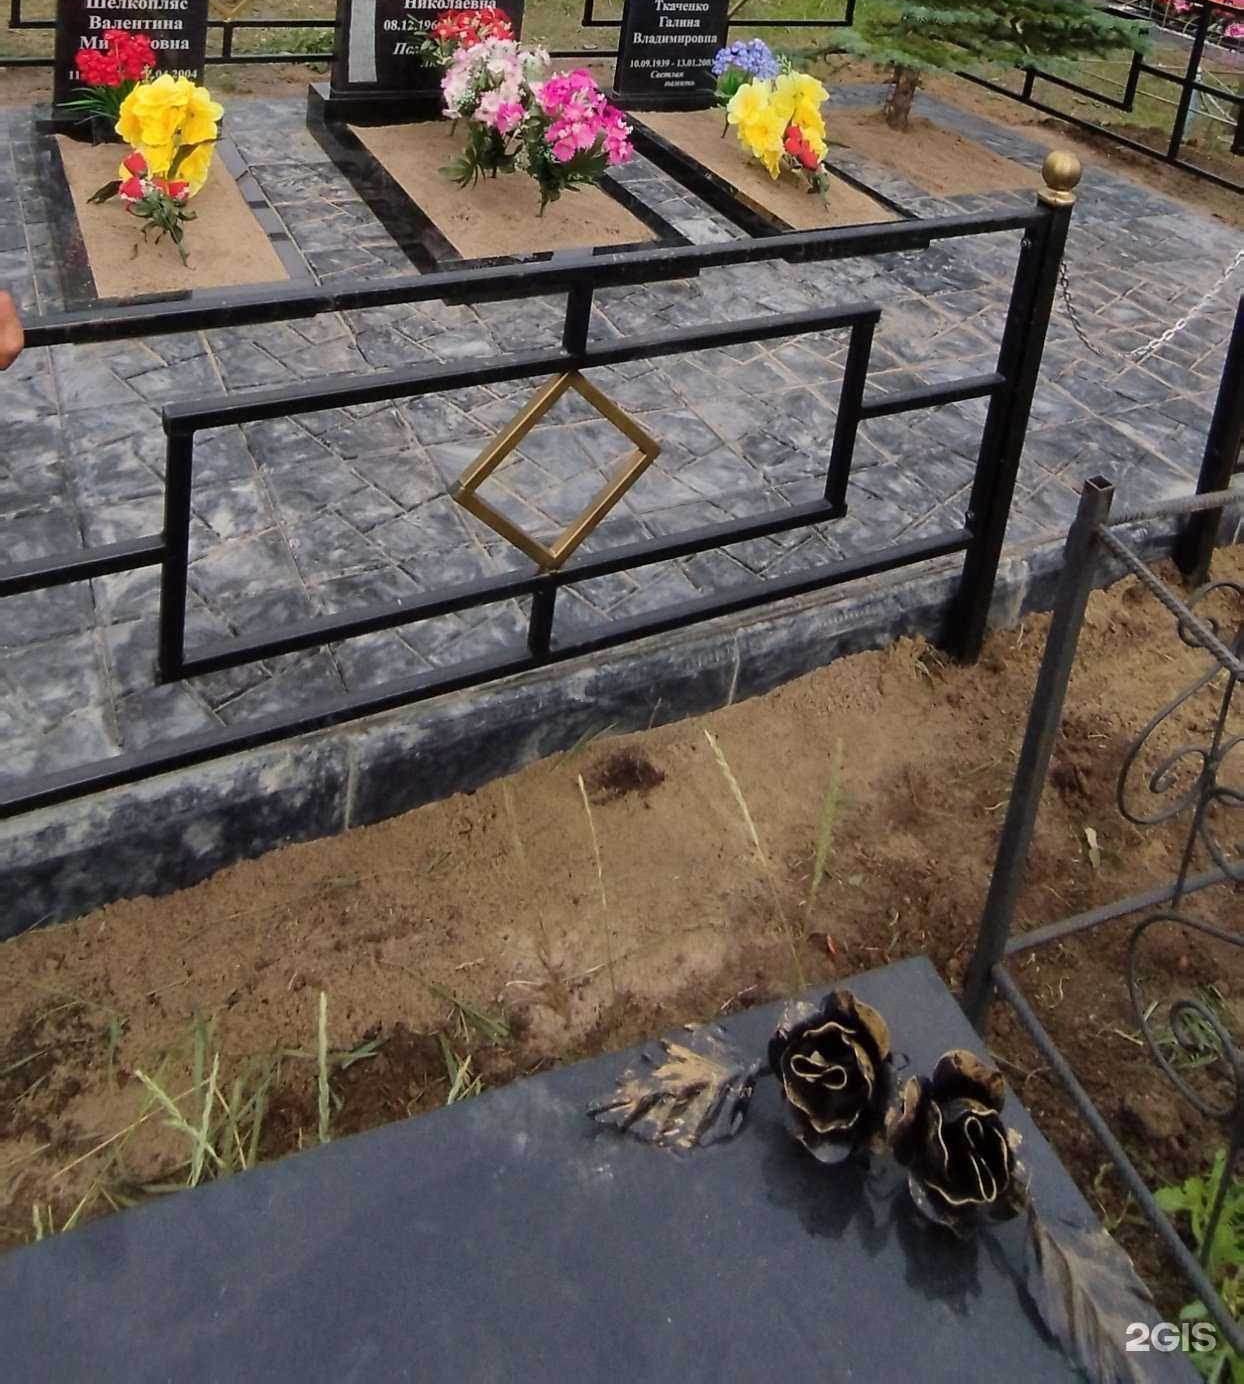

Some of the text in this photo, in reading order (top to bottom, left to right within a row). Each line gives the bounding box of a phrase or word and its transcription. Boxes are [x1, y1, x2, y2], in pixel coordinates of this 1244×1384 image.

[655, 0, 710, 12] Ткаченко
[90, 16, 184, 30] Валентина
[658, 16, 701, 28] Галина
[80, 35, 190, 50] Миовна
[632, 32, 718, 46] Владимировна
